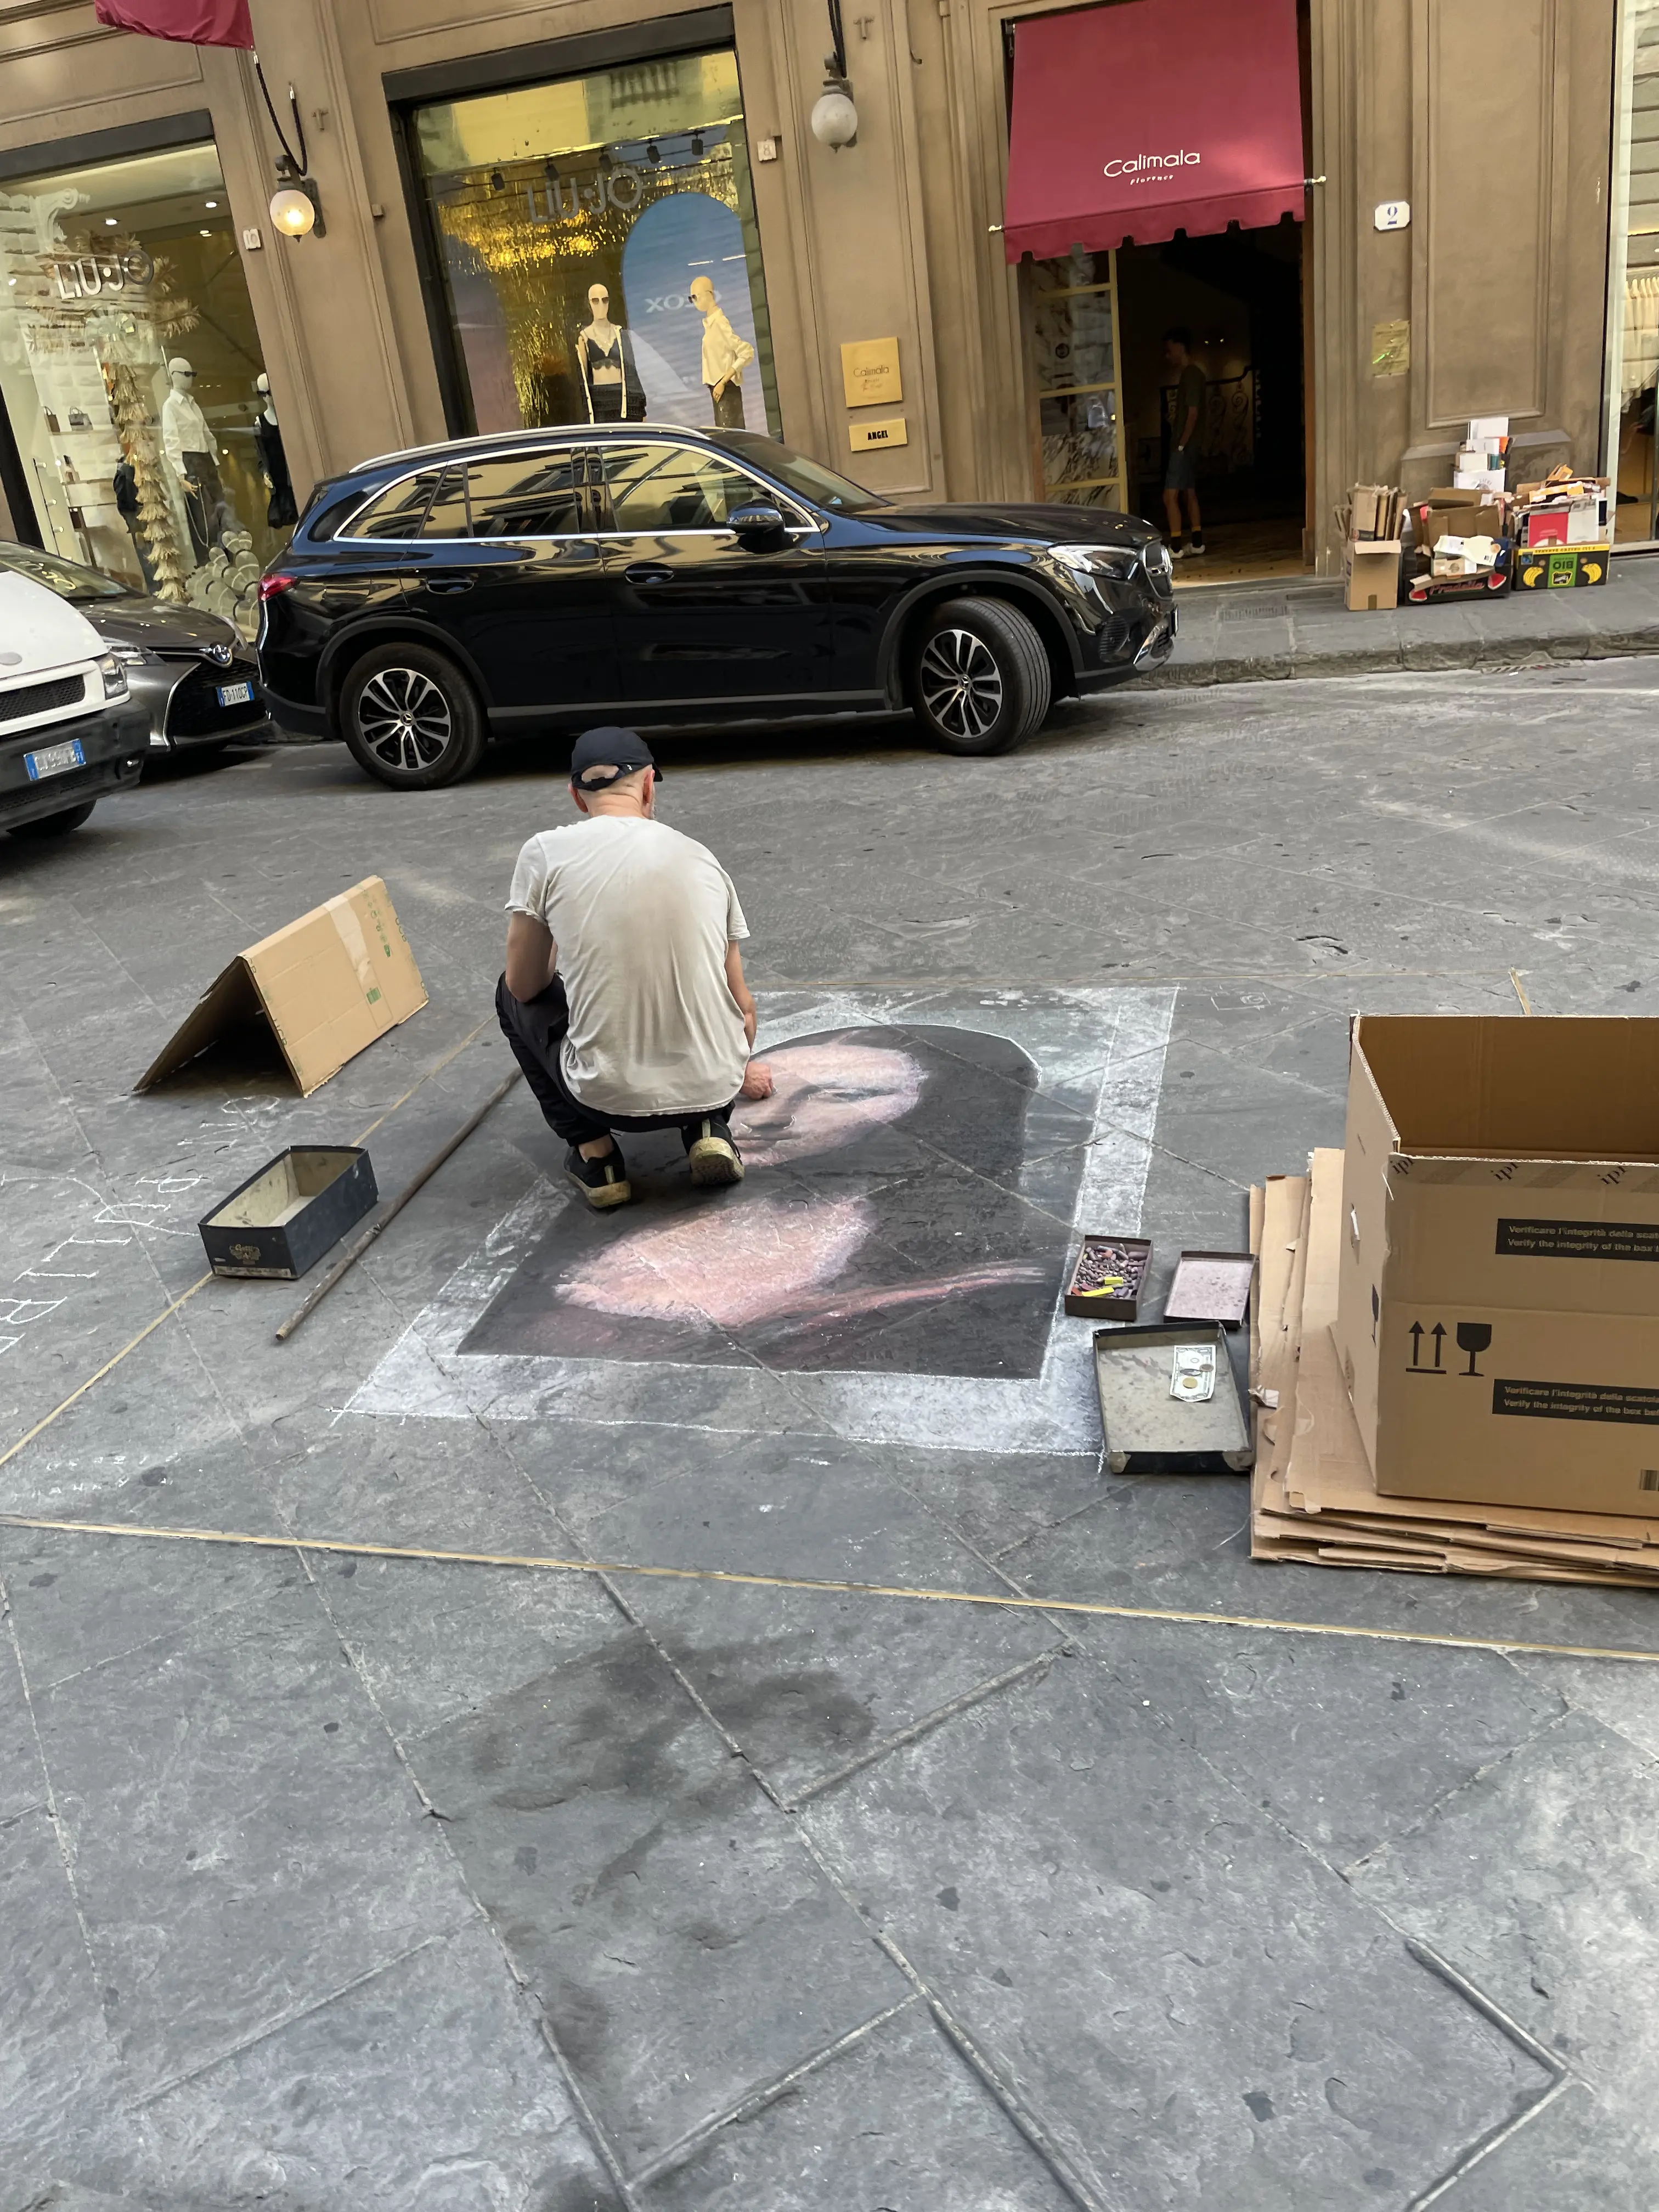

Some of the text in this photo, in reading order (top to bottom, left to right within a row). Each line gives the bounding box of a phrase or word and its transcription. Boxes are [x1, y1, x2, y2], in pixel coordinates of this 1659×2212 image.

[1103, 149, 1201, 177] Calimala
[1387, 206, 1398, 225] 2
[867, 430, 889, 441] ANGEL
[1553, 561, 1574, 569] BIO
[1509, 1226, 1556, 1234] Verificare
[1608, 1229, 1634, 1238] della
[1508, 1238, 1536, 1249] Verify
[1556, 1241, 1599, 1251] integrity
[1614, 1243, 1632, 1251] the
[1504, 1386, 1549, 1396] Verificare
[1599, 1392, 1623, 1401] della
[1504, 1399, 1531, 1409] Verify
[1533, 1400, 1548, 1409] the
[1550, 1402, 1590, 1413] integrity
[1593, 1405, 1603, 1413] of
[1623, 1407, 1642, 1415] box
